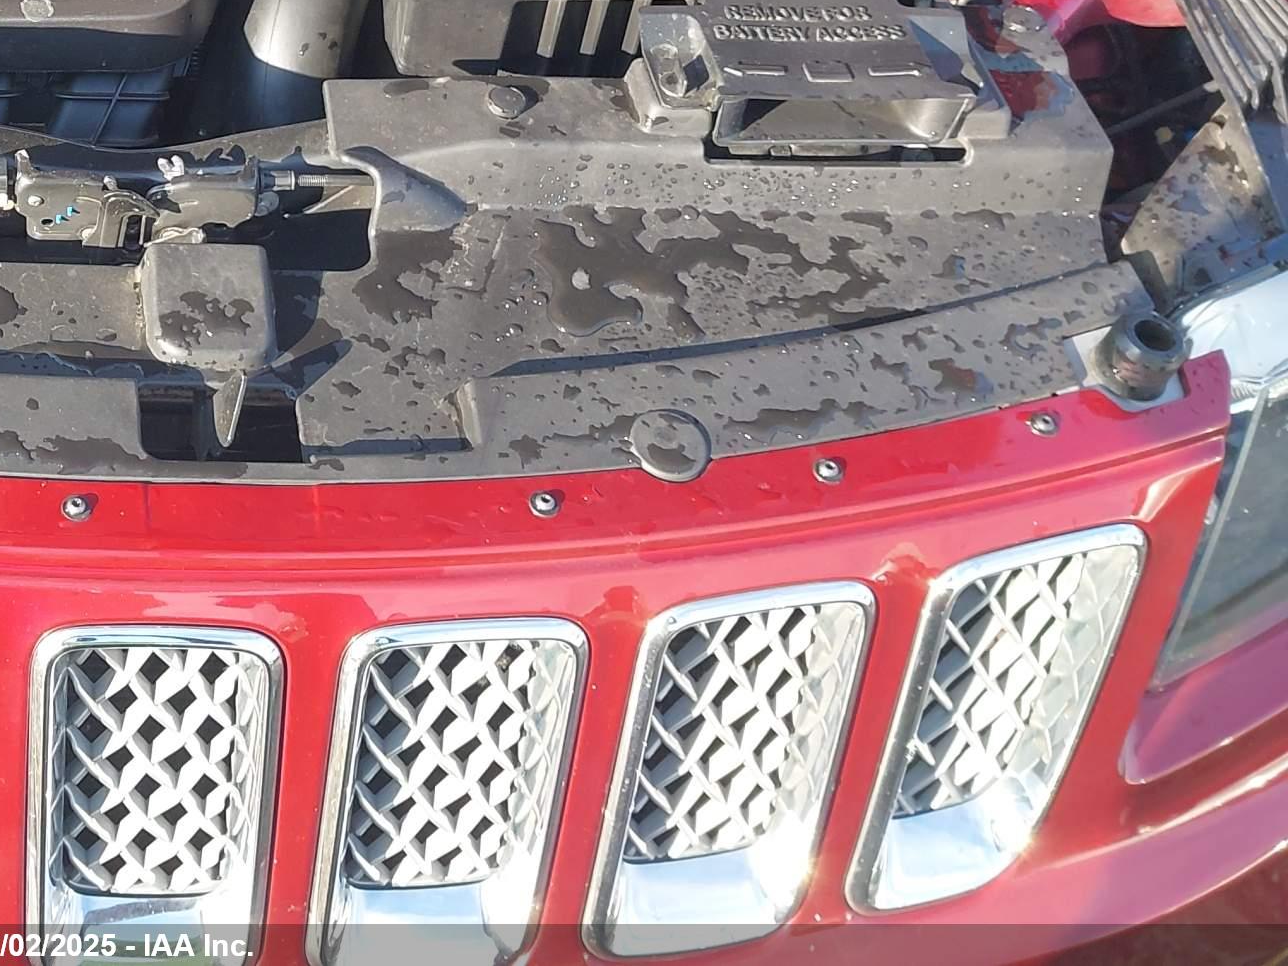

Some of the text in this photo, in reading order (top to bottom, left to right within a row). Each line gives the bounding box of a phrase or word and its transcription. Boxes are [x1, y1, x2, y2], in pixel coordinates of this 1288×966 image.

[723, 4, 873, 23] REMOVE FOR
[712, 23, 909, 43] BATTERY ACCESS
